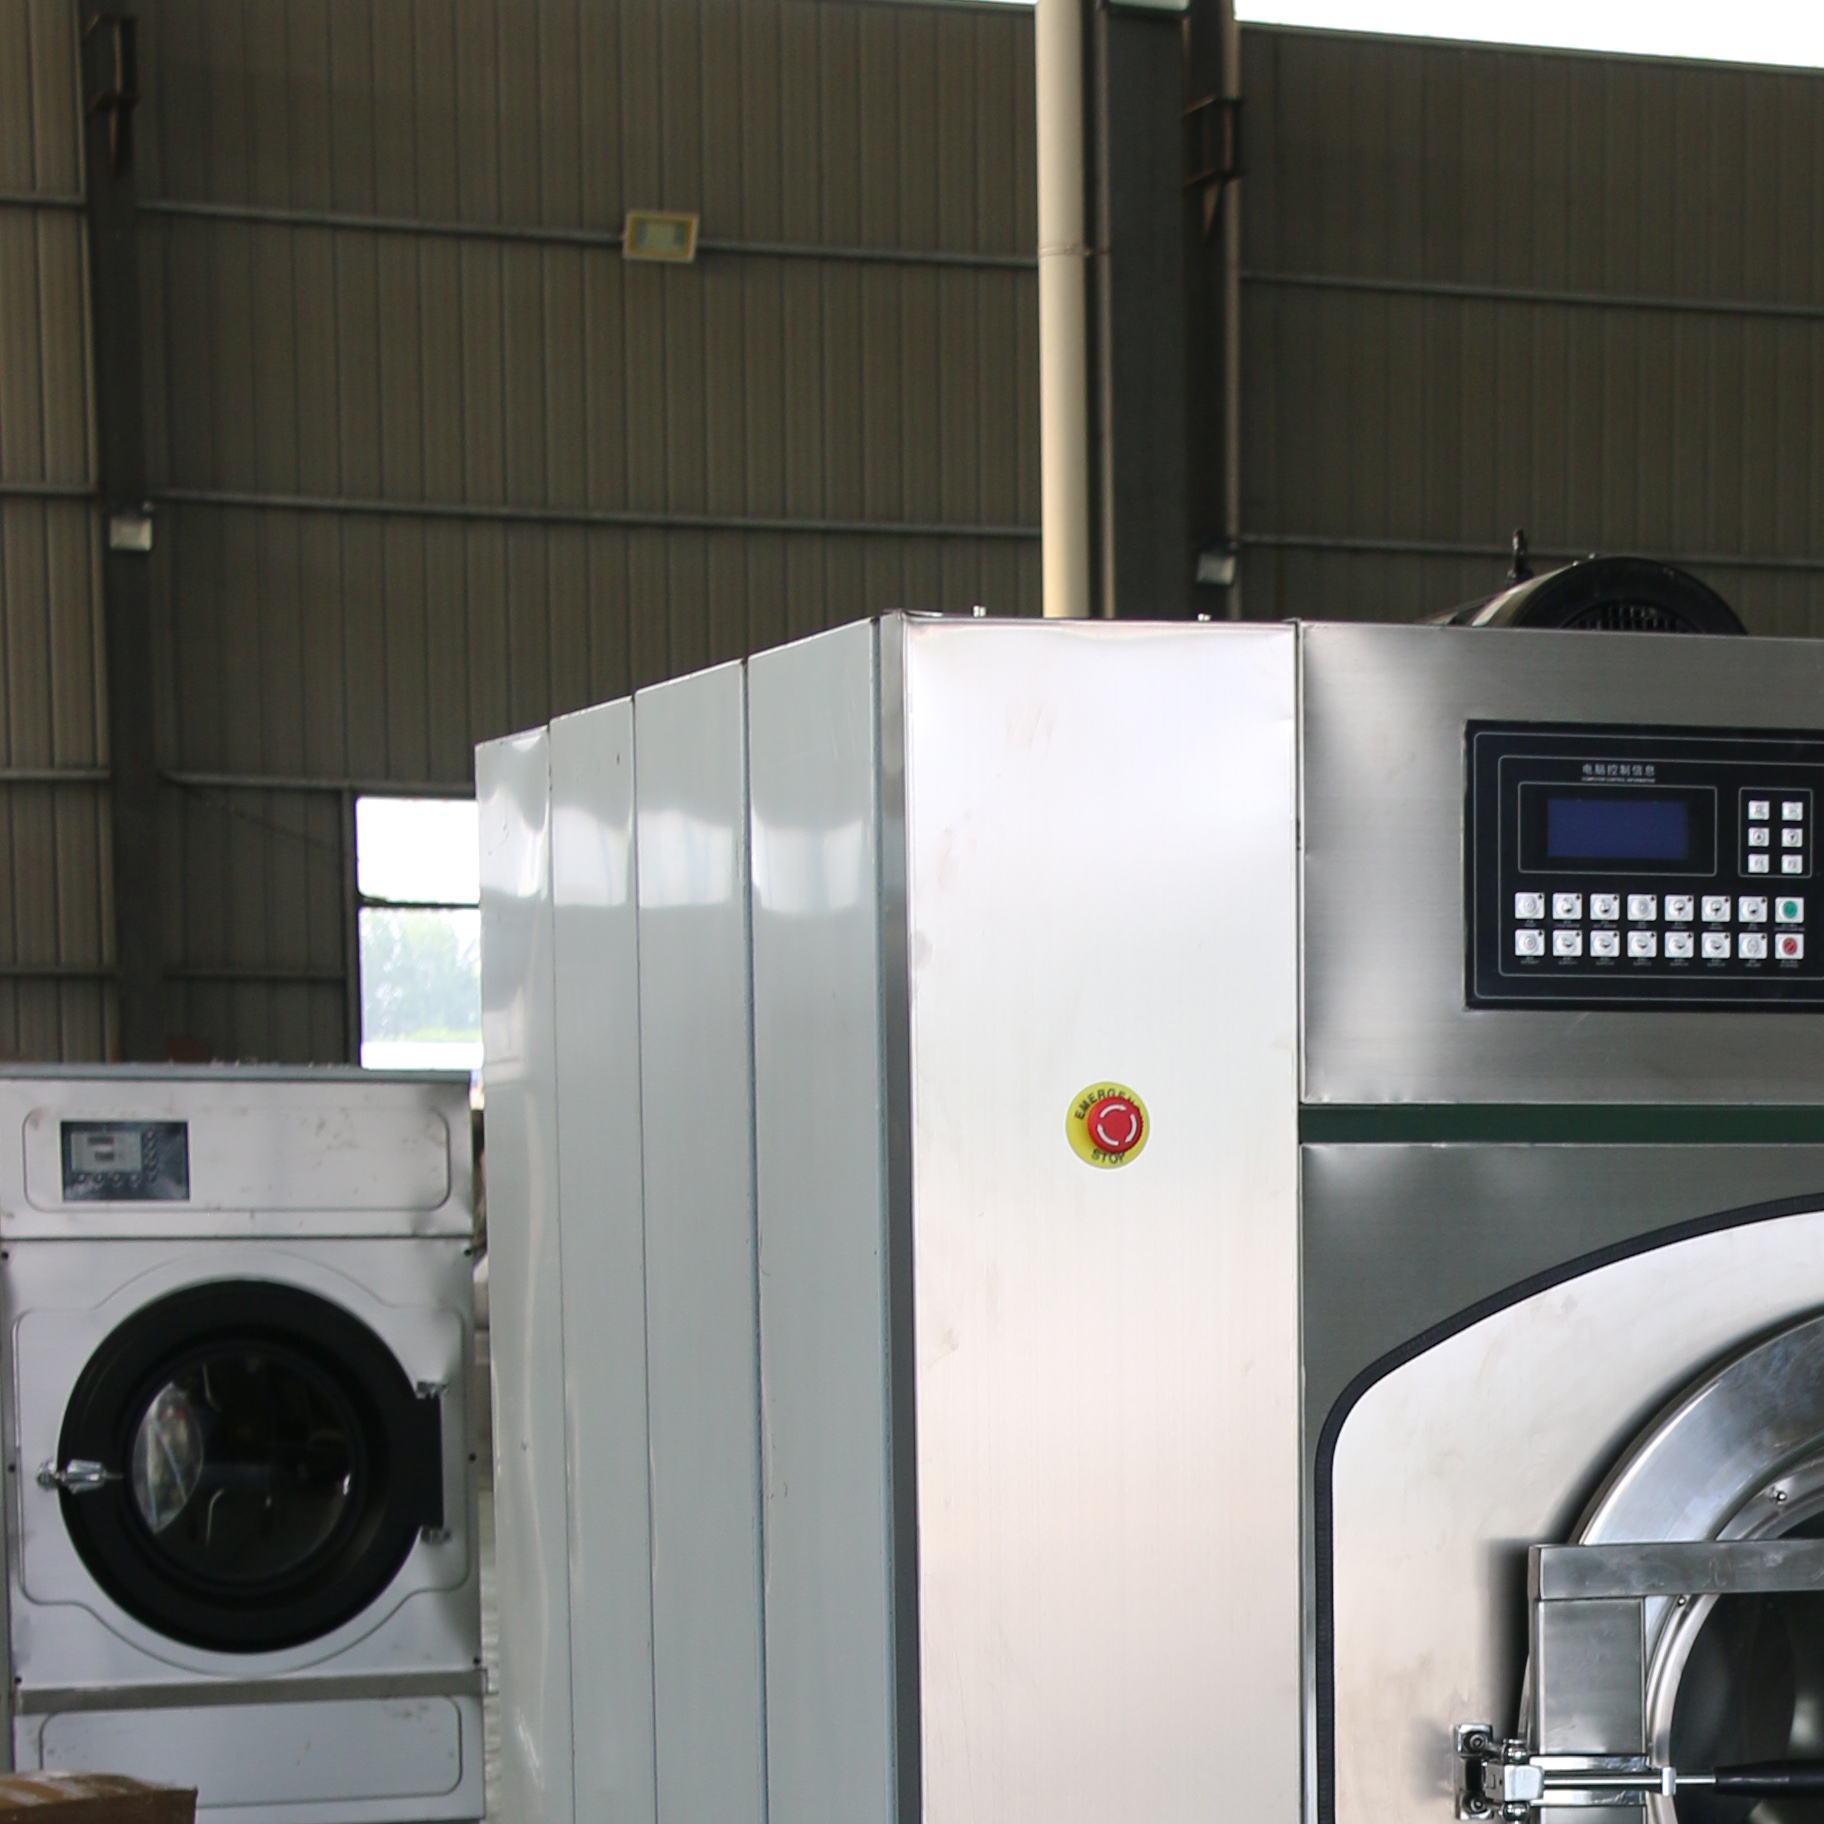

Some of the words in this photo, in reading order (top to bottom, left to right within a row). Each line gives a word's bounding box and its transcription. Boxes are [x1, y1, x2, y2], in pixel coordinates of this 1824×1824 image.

[1582, 763, 1655, 777] 电脑控制信息
